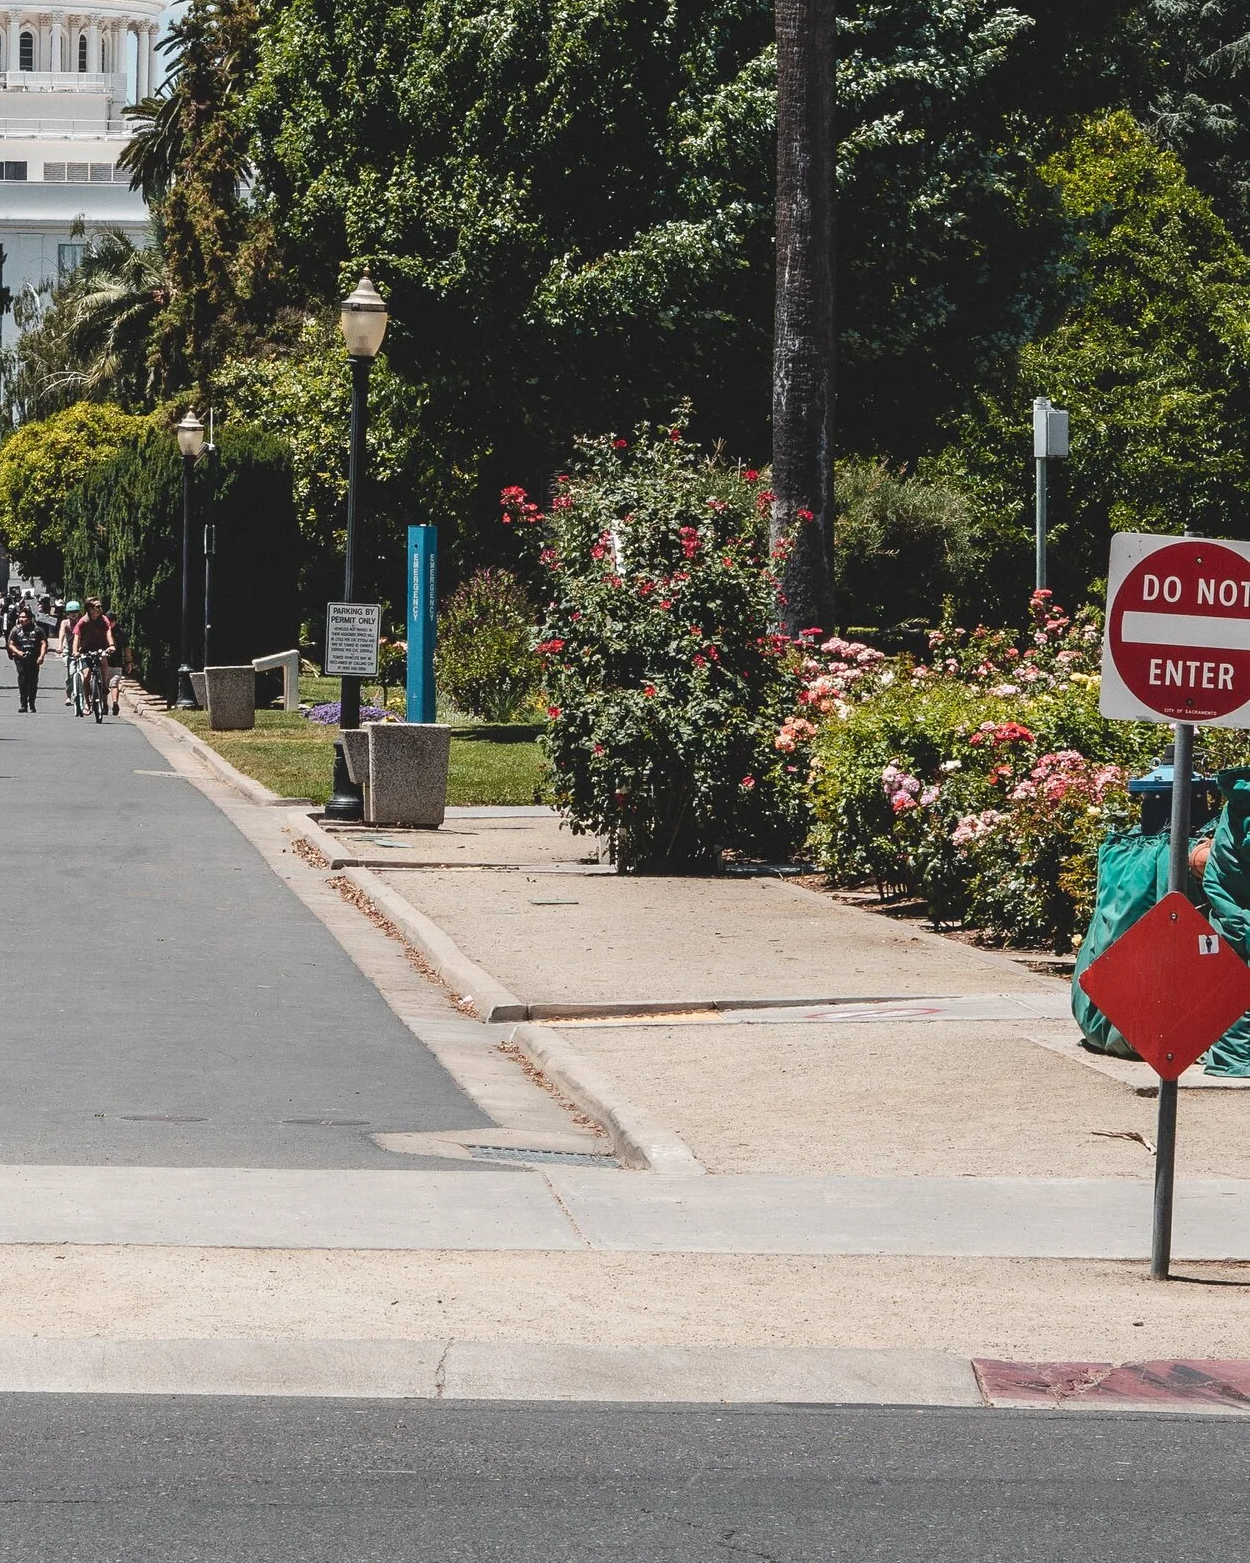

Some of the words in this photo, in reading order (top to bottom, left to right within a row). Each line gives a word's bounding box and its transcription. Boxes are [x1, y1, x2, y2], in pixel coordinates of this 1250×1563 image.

[1143, 574, 1182, 603] DO
[1197, 578, 1250, 608] NOT
[331, 616, 356, 624] PERMIT
[359, 617, 376, 625] ONLY
[333, 607, 363, 615] PARKING
[365, 608, 375, 616] BY
[1149, 658, 1234, 690] ENTER
